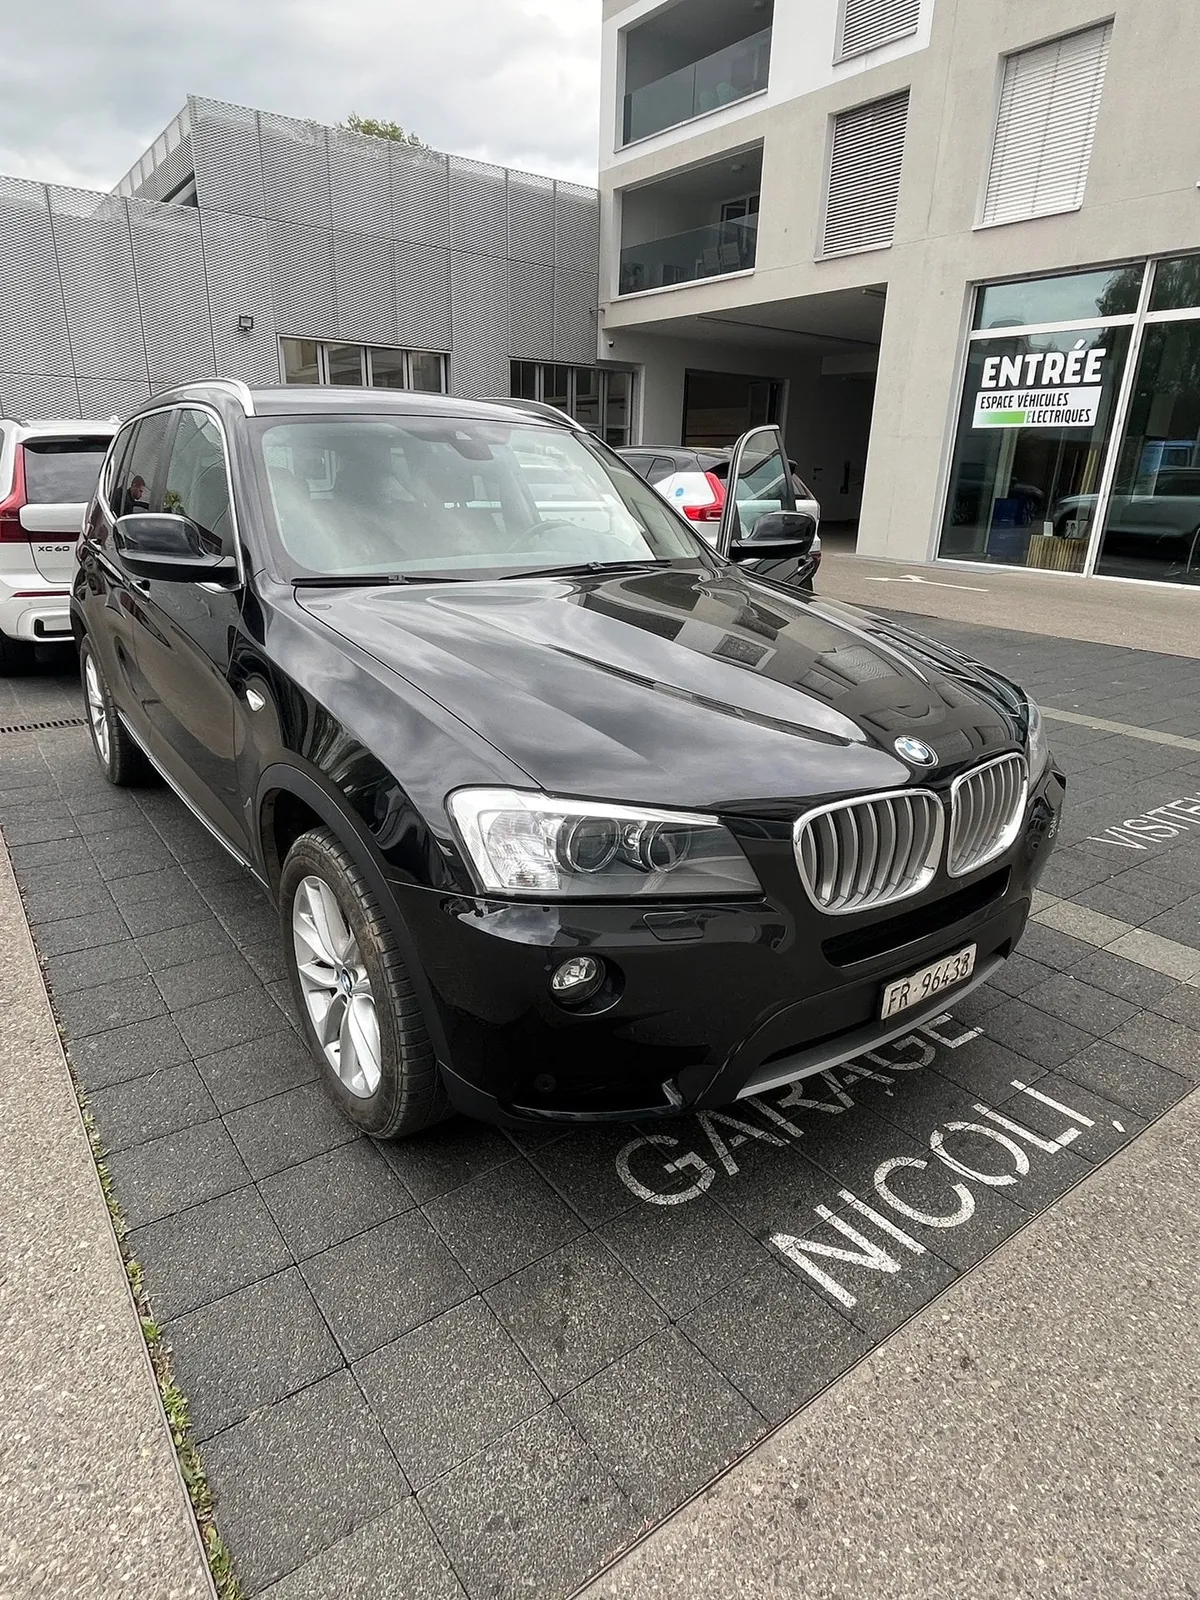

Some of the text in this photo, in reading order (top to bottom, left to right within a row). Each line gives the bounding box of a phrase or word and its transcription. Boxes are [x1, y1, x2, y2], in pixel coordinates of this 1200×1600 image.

[981, 338, 1106, 388] ENTRÉE
[980, 392, 1070, 410] ESPACE VÉHICULES
[887, 952, 971, 1015] FR 96438
[615, 1013, 985, 1206] GARAGE
